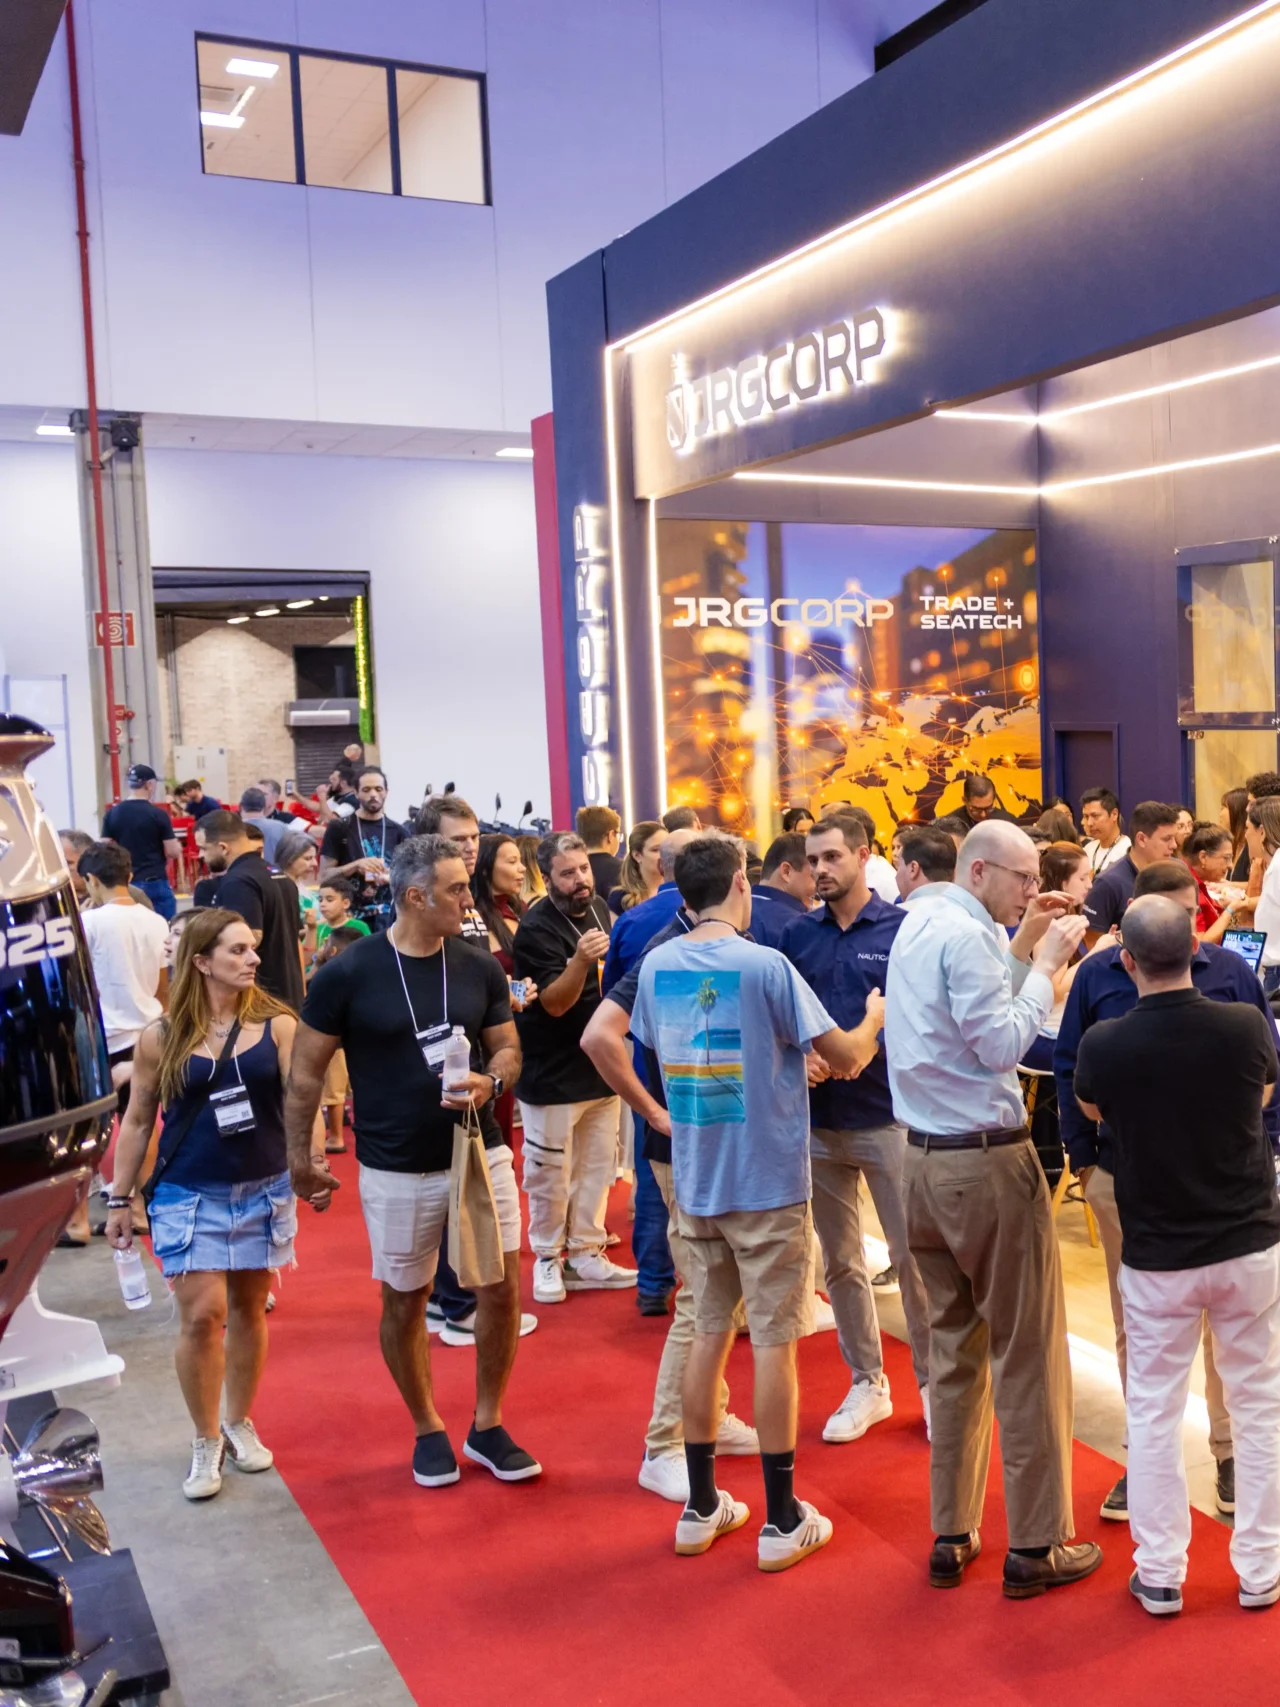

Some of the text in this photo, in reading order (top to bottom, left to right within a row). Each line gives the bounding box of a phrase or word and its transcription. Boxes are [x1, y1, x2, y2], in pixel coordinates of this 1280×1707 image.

[690, 307, 886, 438] JRGCORP
[673, 597, 894, 628] JRGCORP
[919, 596, 998, 611] TRADE
[920, 614, 1023, 630] SEATECH
[0, 916, 75, 969] 25
